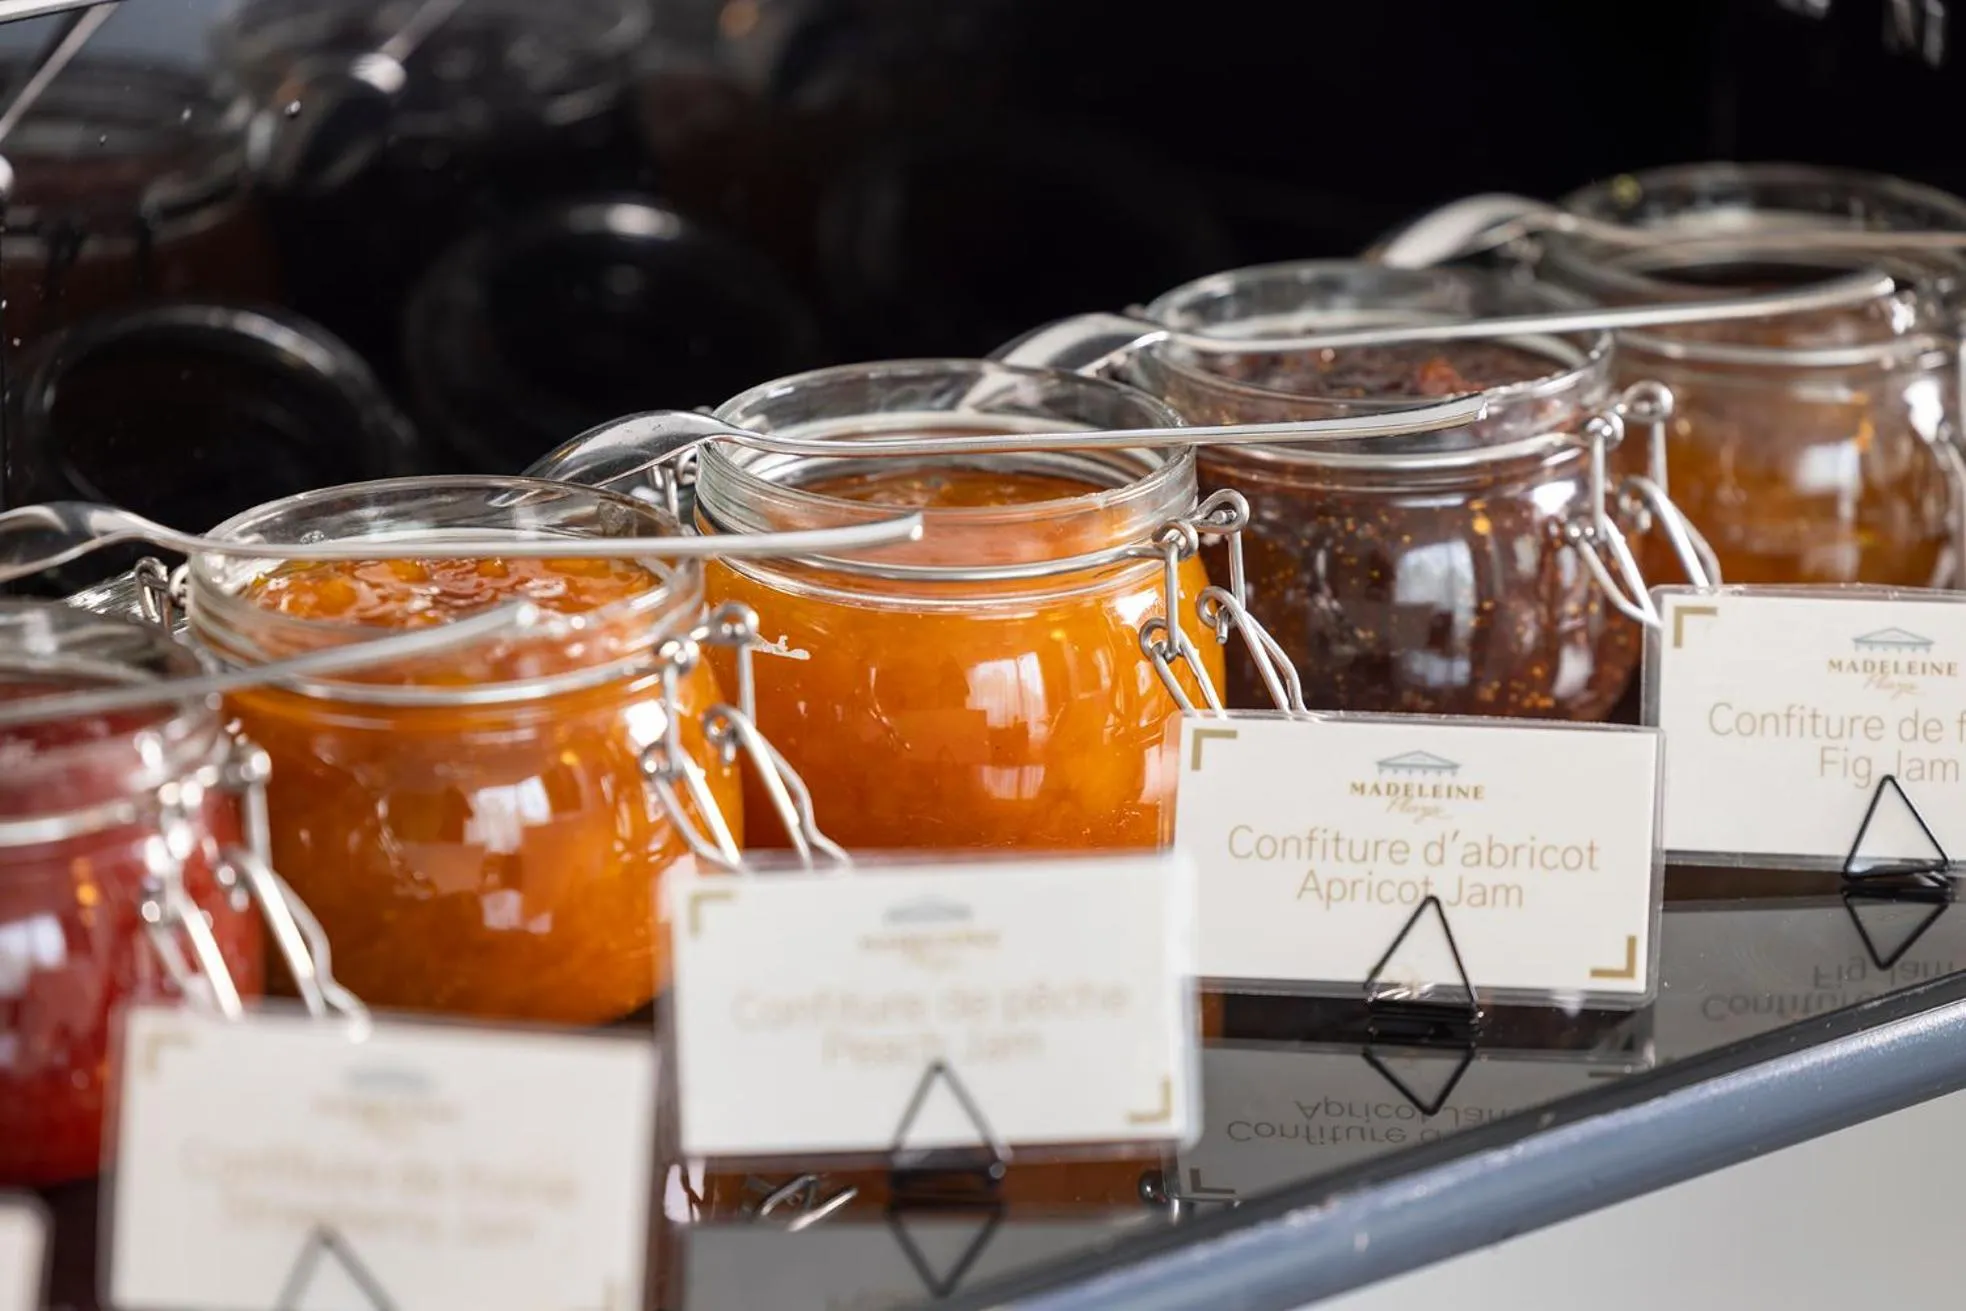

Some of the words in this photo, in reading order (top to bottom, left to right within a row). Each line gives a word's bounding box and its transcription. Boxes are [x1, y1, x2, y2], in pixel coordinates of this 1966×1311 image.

[1827, 658, 1959, 677] MADELEINE
[1708, 701, 1886, 742] Confiture
[1898, 708, 1945, 744] de
[1819, 745, 1874, 790] Fig
[1894, 748, 1960, 784] Jam
[1349, 781, 1486, 800] MADELEINE
[1226, 824, 1411, 866] Confiture
[1422, 829, 1601, 873] d'abricot
[1296, 869, 1435, 911] Apricot
[1451, 878, 1524, 909] Jam
